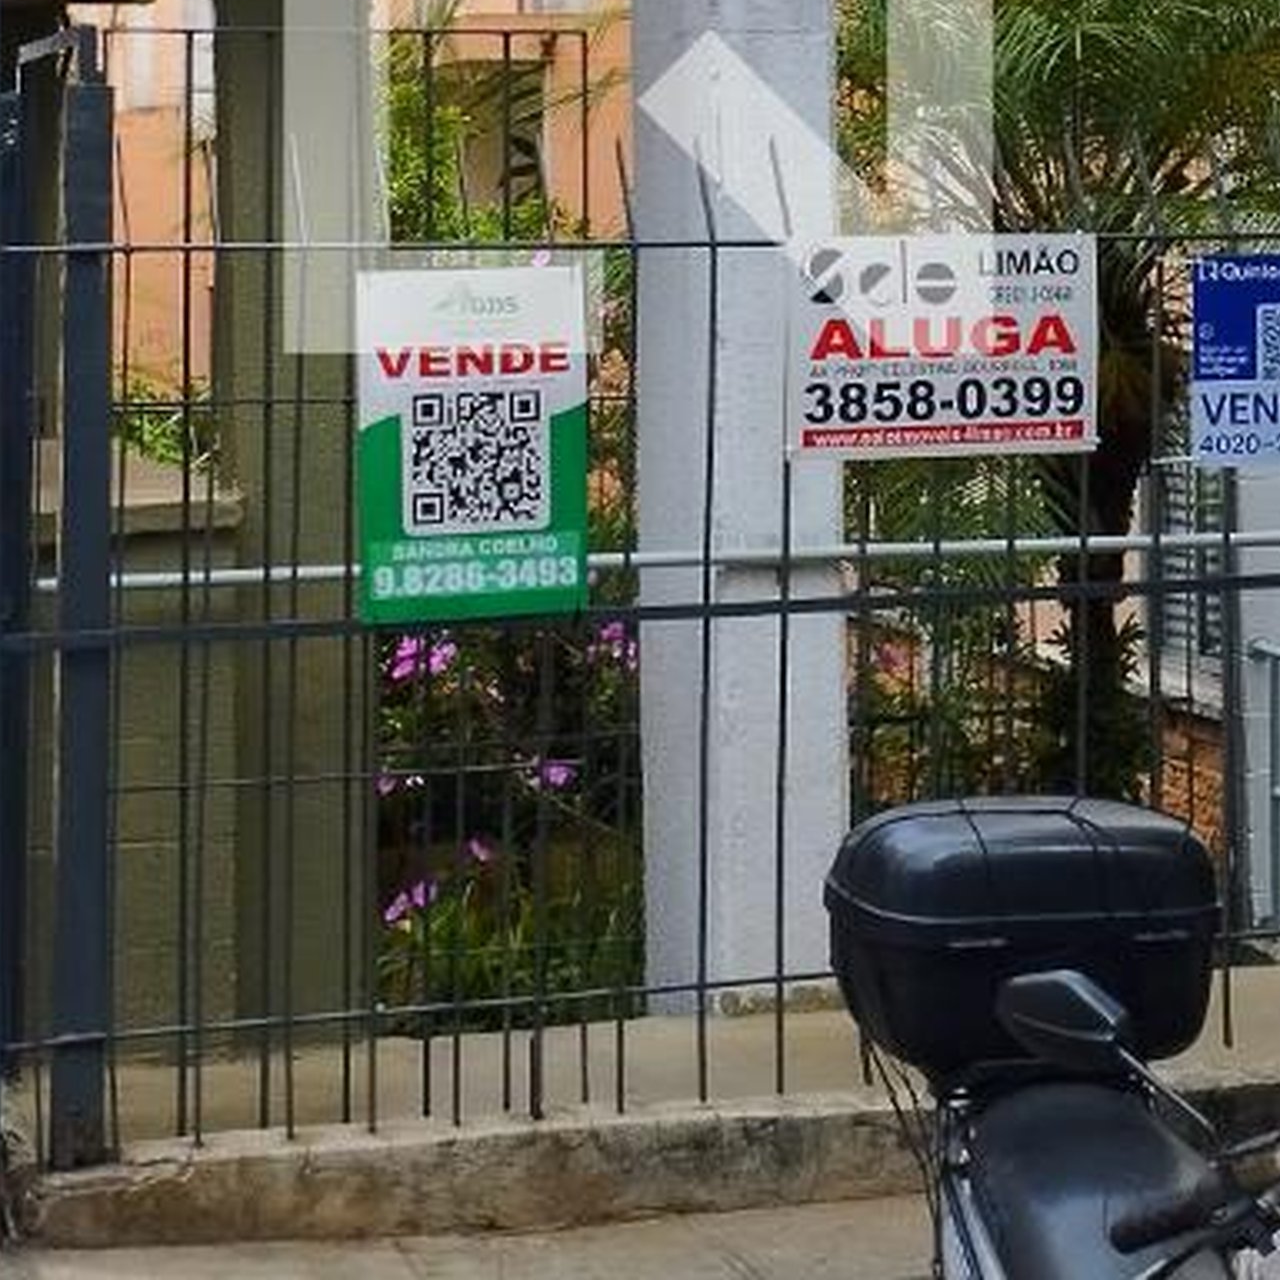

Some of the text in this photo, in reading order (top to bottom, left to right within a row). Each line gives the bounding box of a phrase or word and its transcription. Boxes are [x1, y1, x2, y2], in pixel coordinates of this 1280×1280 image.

[979, 245, 1081, 276] LIMÃO
[810, 314, 1077, 360] ALUGA
[375, 341, 571, 378] VENDE
[804, 376, 1084, 423] 3858-0399
